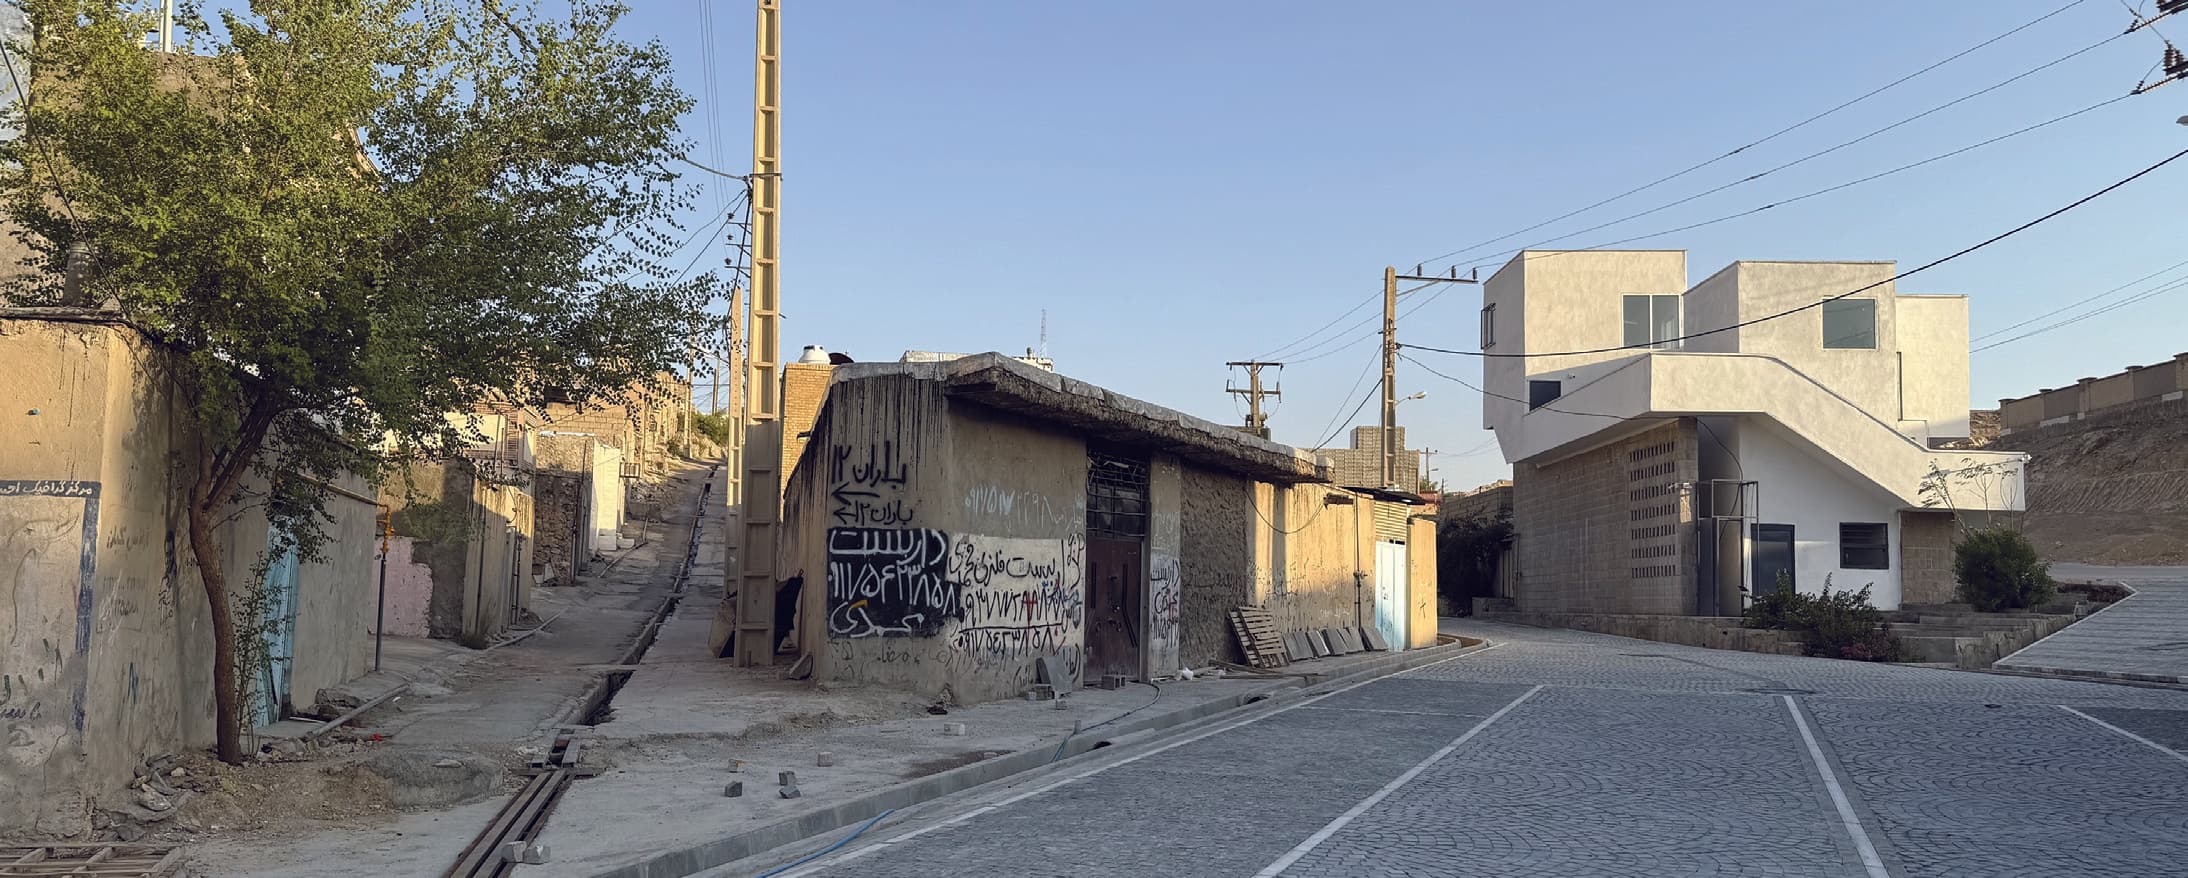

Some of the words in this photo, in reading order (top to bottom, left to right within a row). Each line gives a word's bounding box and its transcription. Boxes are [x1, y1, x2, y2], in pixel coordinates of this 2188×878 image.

[853, 440, 907, 489] باران
[22, 480, 66, 496] گرافیک
[65, 480, 93, 496] مرکز
[871, 499, 913, 526] باران
[829, 528, 946, 568] داربست
